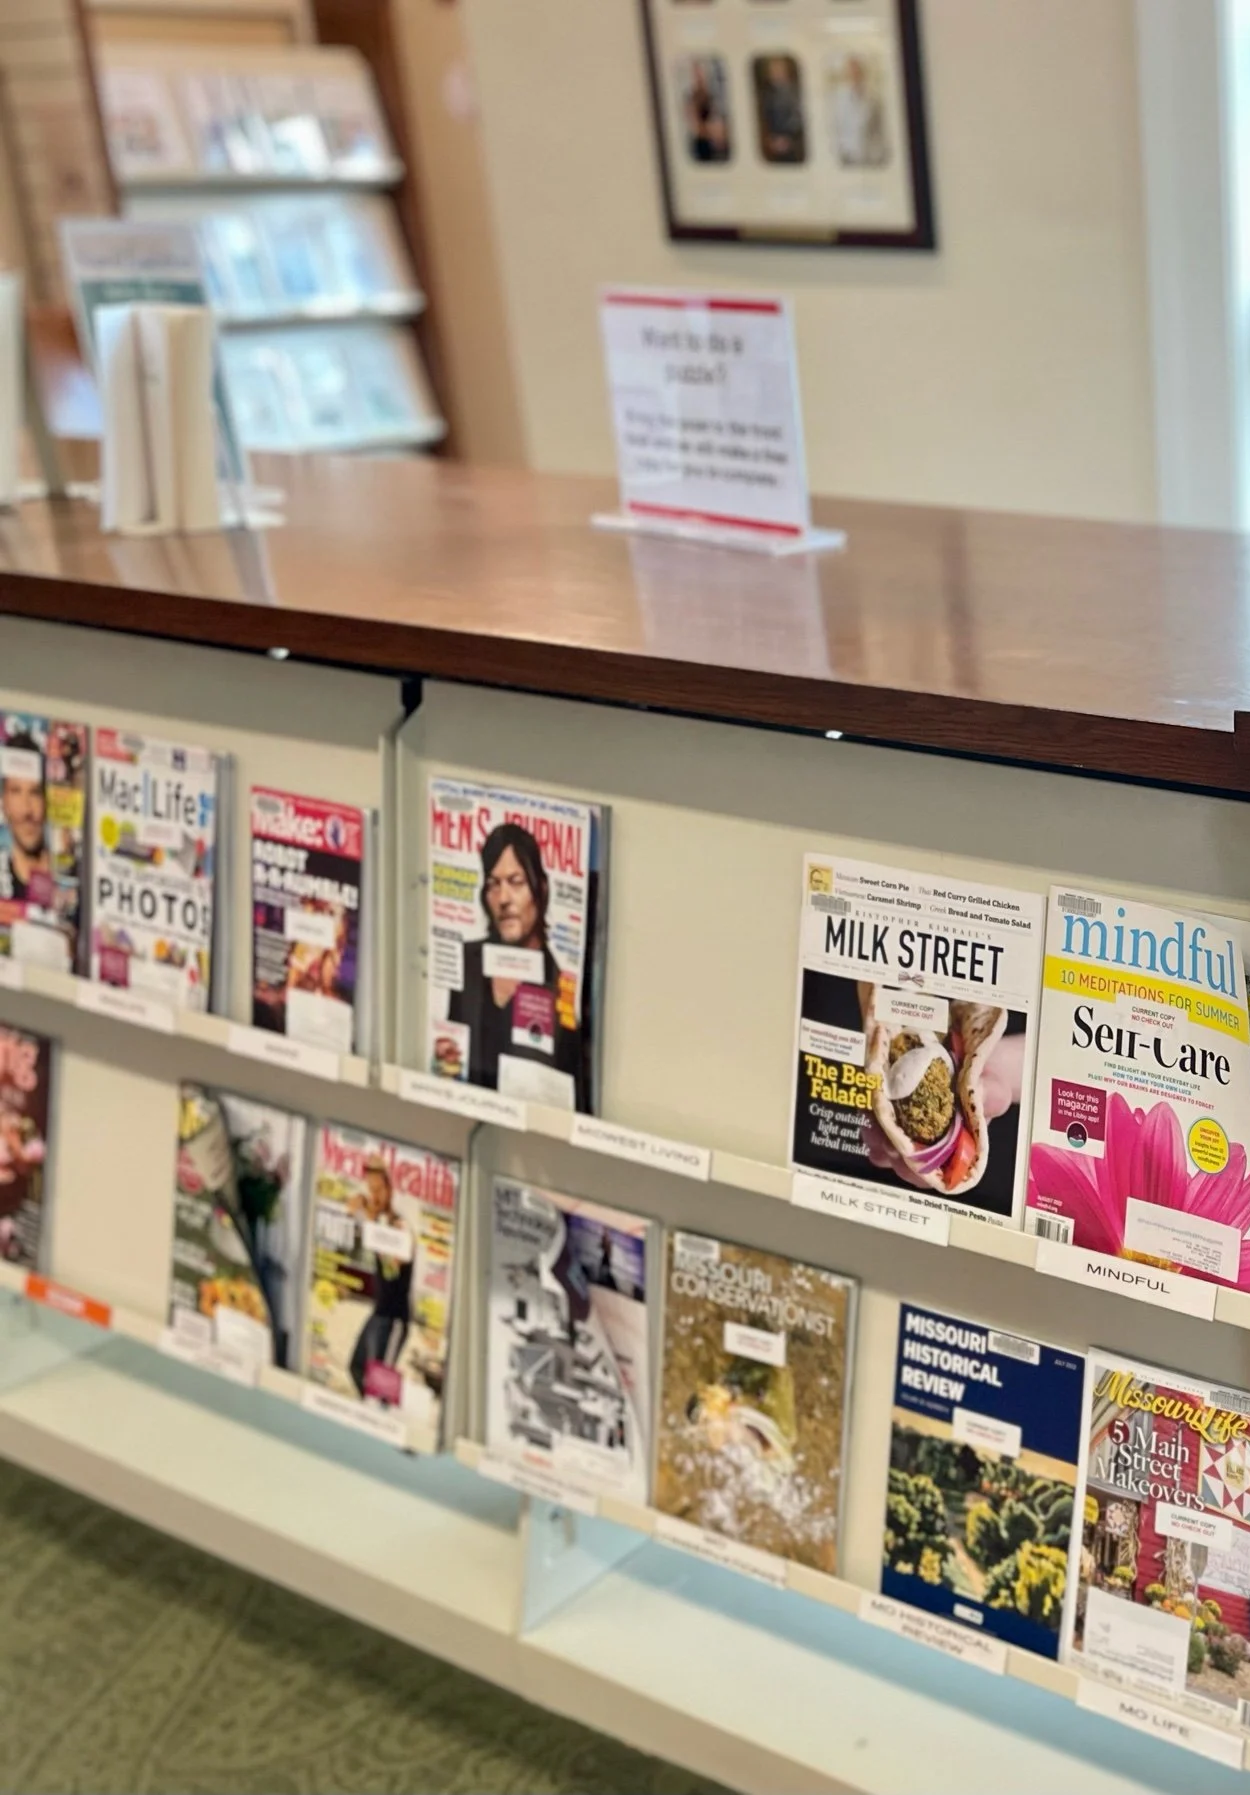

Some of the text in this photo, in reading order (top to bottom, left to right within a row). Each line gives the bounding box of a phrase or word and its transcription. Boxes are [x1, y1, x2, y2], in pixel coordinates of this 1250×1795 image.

[859, 876, 880, 886] Sweet
[881, 880, 897, 890] Corn
[898, 883, 910, 892] Pie
[933, 889, 946, 899] Red
[948, 892, 967, 903] Curry
[968, 895, 991, 906] Grilled
[992, 899, 1020, 911] Chicken
[867, 893, 895, 905] Caramel
[897, 898, 922, 911] Shrimp
[948, 908, 968, 918] Bread
[970, 912, 983, 920] and
[984, 914, 1010, 926] Tomato
[1011, 919, 1031, 929] Salad
[825, 915, 1004, 985] MILK STREET
[1061, 907, 1238, 1000] mindful
[891, 999, 935, 1013] CURRENT COPY
[1061, 970, 1240, 1030] 10 MEDITATIONS FOR SUMMER
[1132, 1006, 1176, 1022] CURRENT COPY
[1131, 1014, 1140, 1022] NO
[1141, 1016, 1160, 1028] CHECK
[1072, 1005, 1231, 1085] Self-Care
[804, 1054, 883, 1090] The Best
[1117, 1064, 1139, 1074] DELIGHT
[1148, 1071, 1161, 1080] YOUR
[1163, 1075, 1190, 1087] EVERYDAY
[810, 1079, 873, 1110] Falafel
[1058, 1088, 1099, 1104] Look for this
[1058, 1098, 1098, 1113] magazine
[809, 1103, 872, 1128] Crisp outside,
[818, 1120, 861, 1139] light and
[577, 1123, 701, 1167] MIDWEST LIVING
[810, 1132, 870, 1156] herbal inside
[821, 1191, 930, 1225] MILK STREET
[1087, 1262, 1171, 1294] MINDFUL
[670, 1273, 836, 1336] CONSERVATIONIST
[905, 1312, 987, 1354] MISSOURI
[903, 1339, 1003, 1387] HISTORICAL
[901, 1365, 965, 1402] REVIEW
[1093, 1370, 1248, 1444] Missouri Life
[1112, 1420, 1190, 1463] 5 Main
[1118, 1444, 1182, 1481] Street
[1095, 1456, 1205, 1512] Makeovers
[1171, 1513, 1216, 1530] CURRENT COPY
[870, 1598, 995, 1653] MO HISTORICAL
[900, 1624, 964, 1656] REVIEW
[1118, 1701, 1190, 1738] MO LIFE
